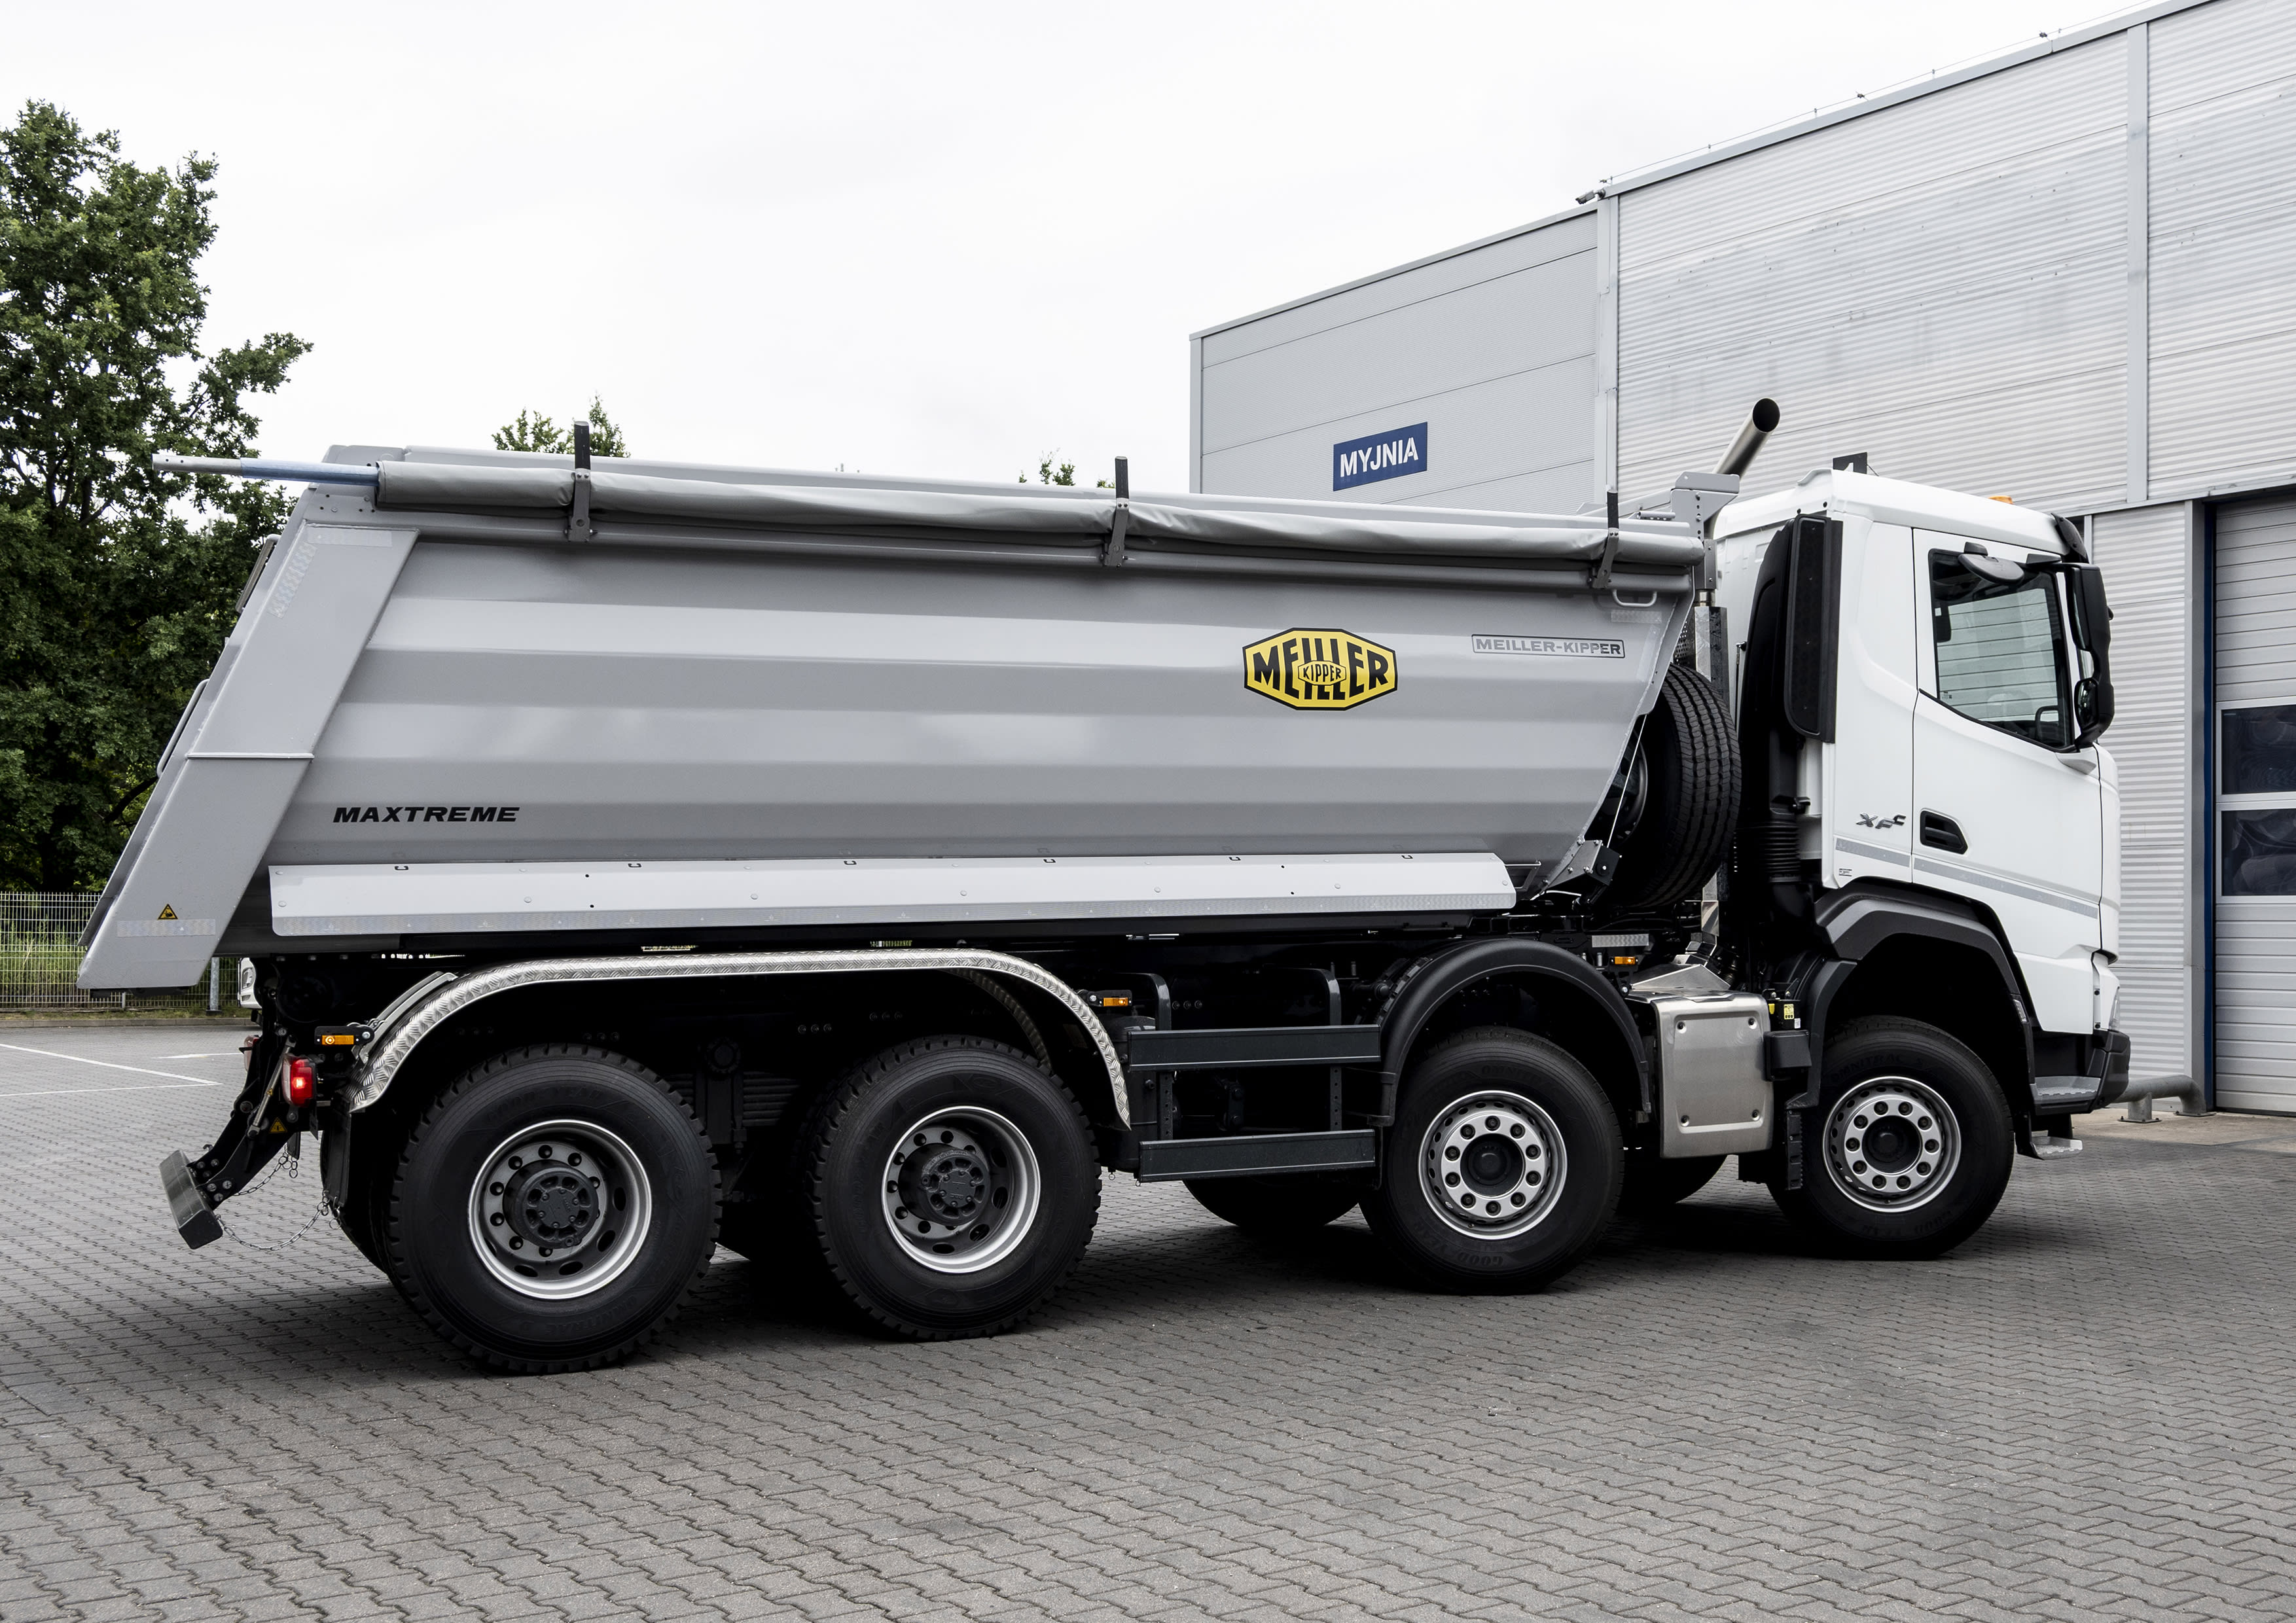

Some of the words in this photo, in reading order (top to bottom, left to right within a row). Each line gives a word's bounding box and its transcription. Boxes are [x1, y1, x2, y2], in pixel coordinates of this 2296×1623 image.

[1340, 437, 1419, 478] MYJNIA
[1475, 638, 1622, 655] MEILLER-KIPPER
[1253, 637, 1389, 700] MEILLER
[1302, 663, 1342, 683] KIPPER
[332, 806, 520, 823] MAXTREME
